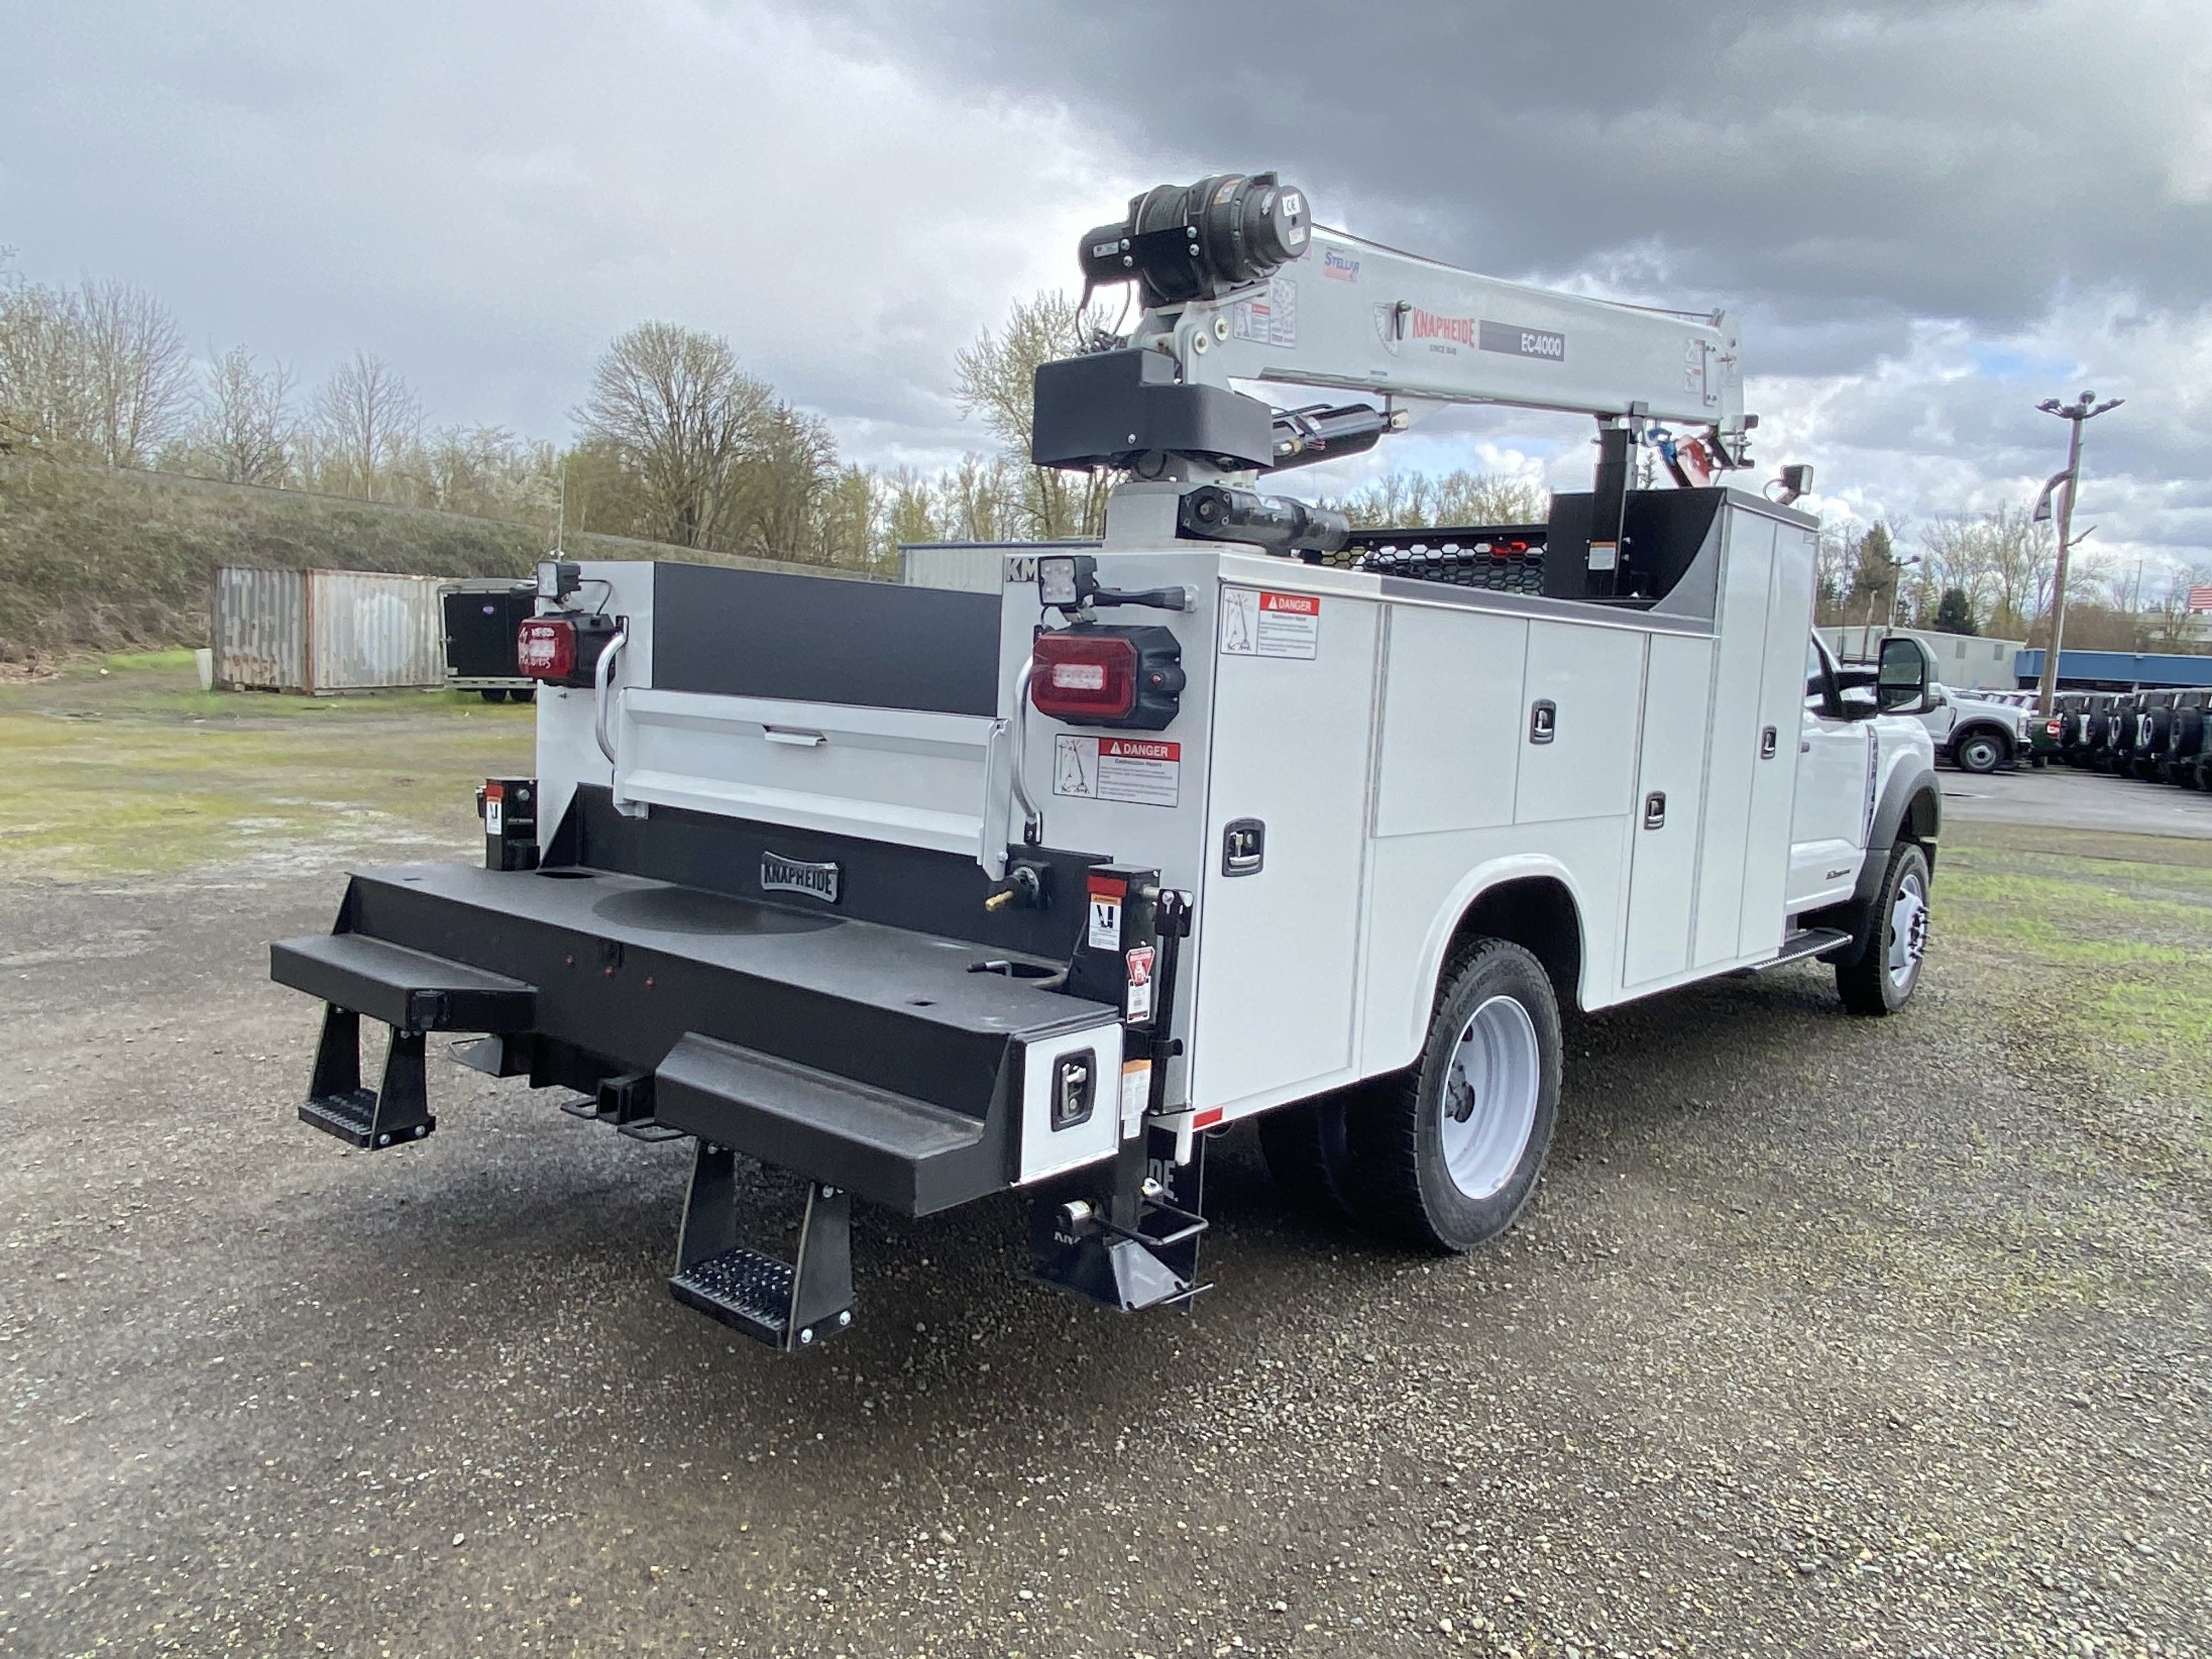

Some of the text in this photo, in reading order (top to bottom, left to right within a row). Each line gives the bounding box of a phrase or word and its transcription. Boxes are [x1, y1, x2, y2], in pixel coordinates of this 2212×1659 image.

[1413, 306, 1475, 349] KNAPHEIDE
[1521, 332, 1562, 357] EC4000
[1278, 597, 1312, 612] DANGER
[1124, 746, 1168, 758] DANGER
[764, 861, 835, 896] KNAPHEIDE
